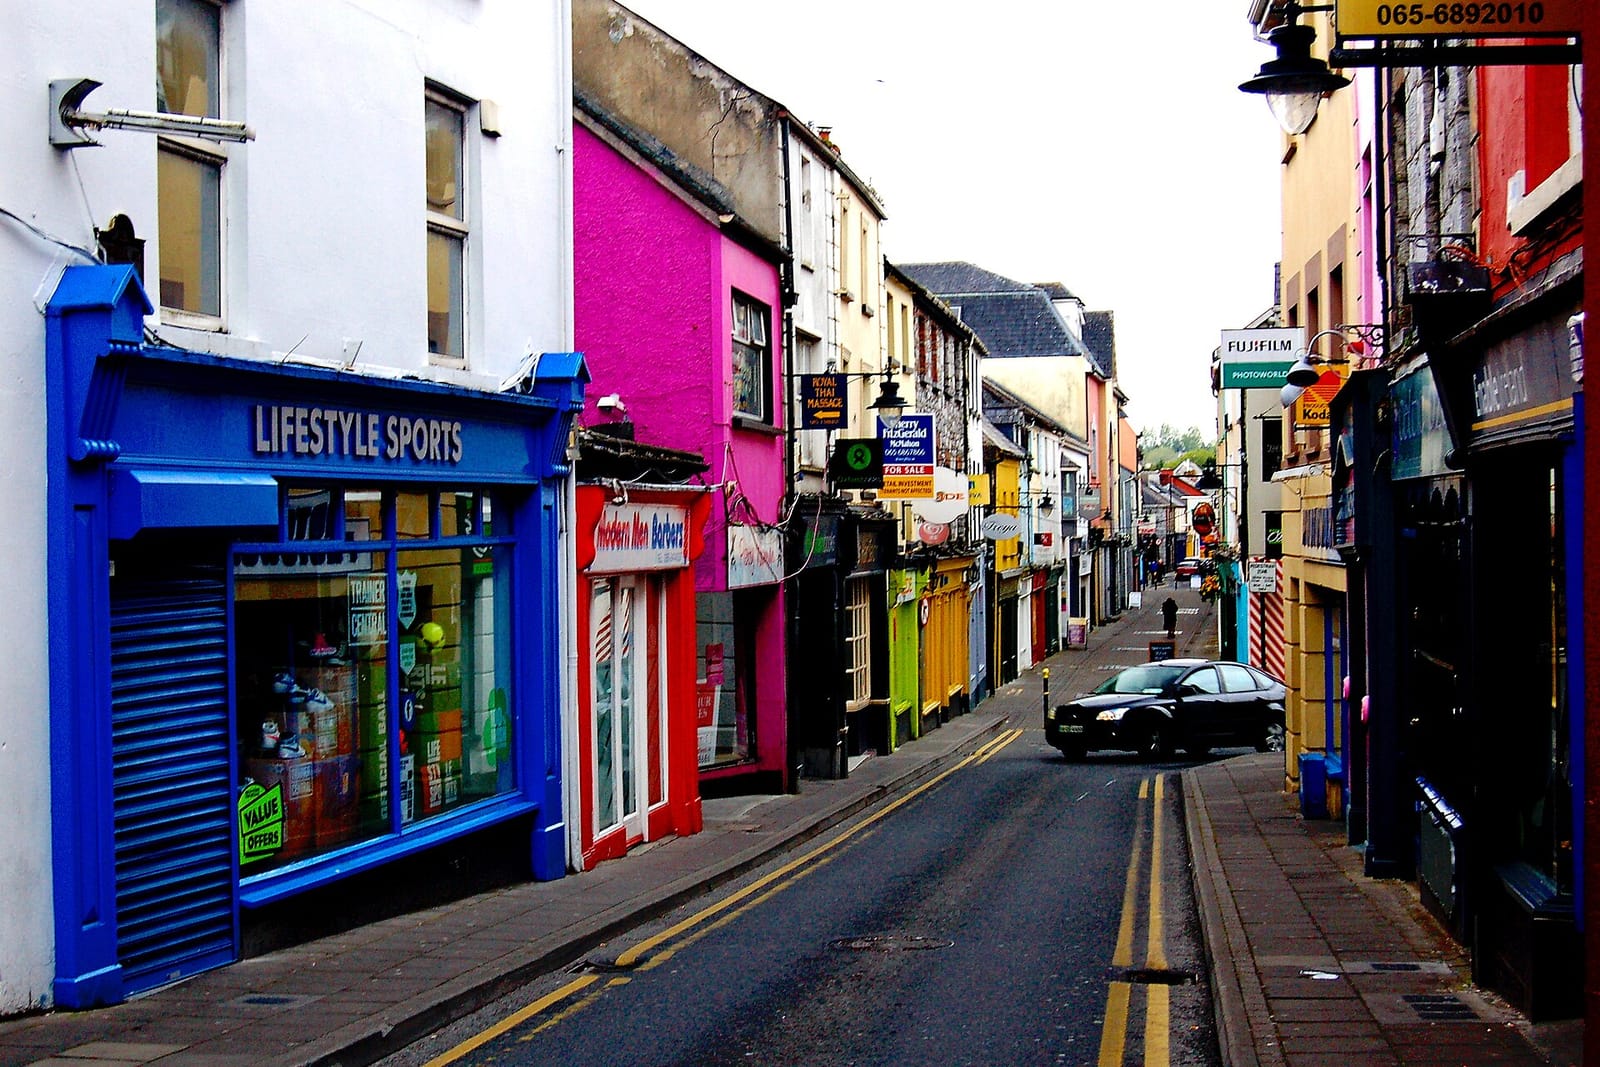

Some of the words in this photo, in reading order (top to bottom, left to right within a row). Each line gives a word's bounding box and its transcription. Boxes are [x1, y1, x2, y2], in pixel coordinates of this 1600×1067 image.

[1377, 2, 1544, 25] 065-6892010
[1228, 339, 1292, 353] FUJIFILM
[812, 376, 837, 388] ROYAL
[814, 387, 835, 397] THAI
[807, 397, 843, 408] MASSAGE
[1303, 408, 1331, 420] Koda
[256, 405, 380, 457] LIFESTYLE
[387, 415, 463, 463] SPORTS
[884, 466, 902, 474] FOR
[904, 466, 925, 474] SALE
[631, 511, 649, 550] Men
[651, 512, 683, 550] Barbers
[351, 580, 386, 604] TRAINER
[351, 611, 387, 638] CENTRAL
[244, 797, 279, 828] VALUE
[248, 830, 279, 850] OFFERS
